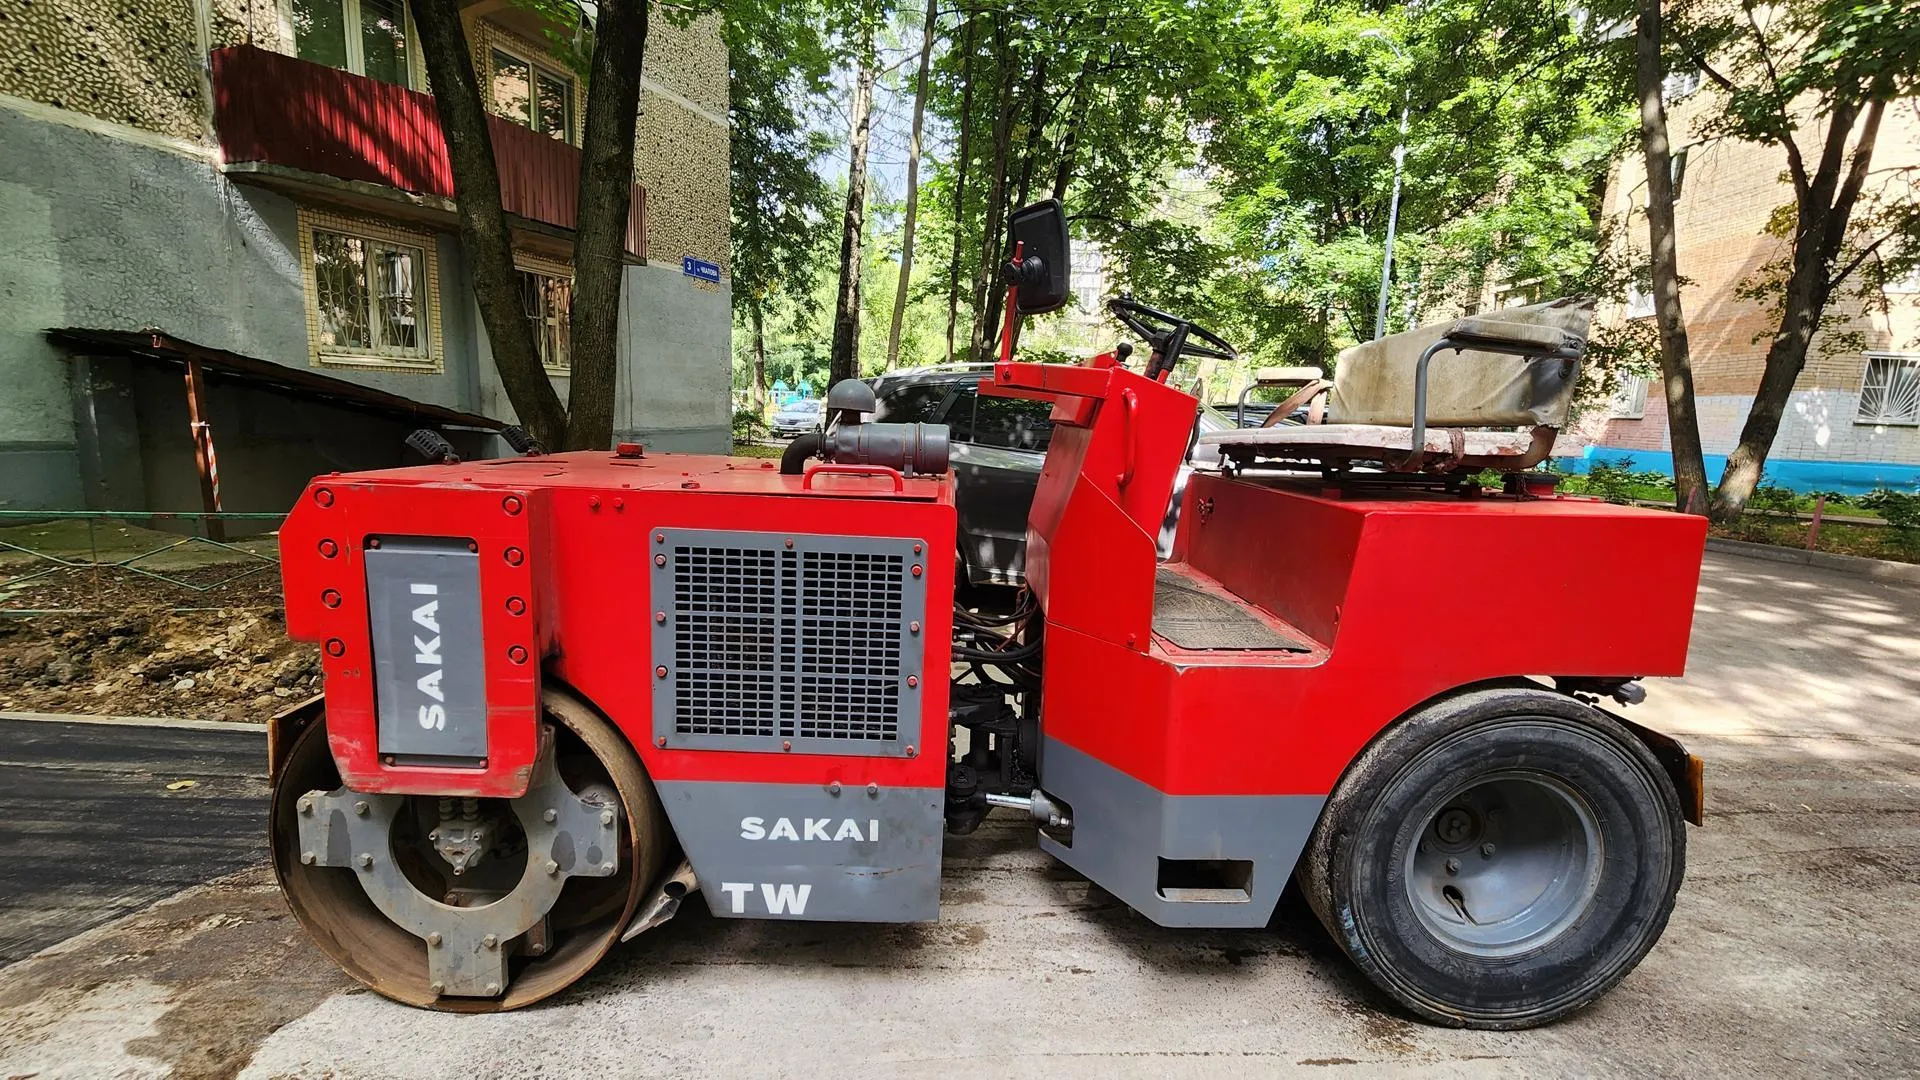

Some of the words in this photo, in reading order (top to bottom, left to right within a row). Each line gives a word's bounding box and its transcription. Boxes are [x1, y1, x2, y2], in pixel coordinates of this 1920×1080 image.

[686, 261, 692, 271] 3
[410, 583, 446, 731] SAKAI
[740, 816, 879, 842] SAKAI
[721, 882, 812, 915] TW
